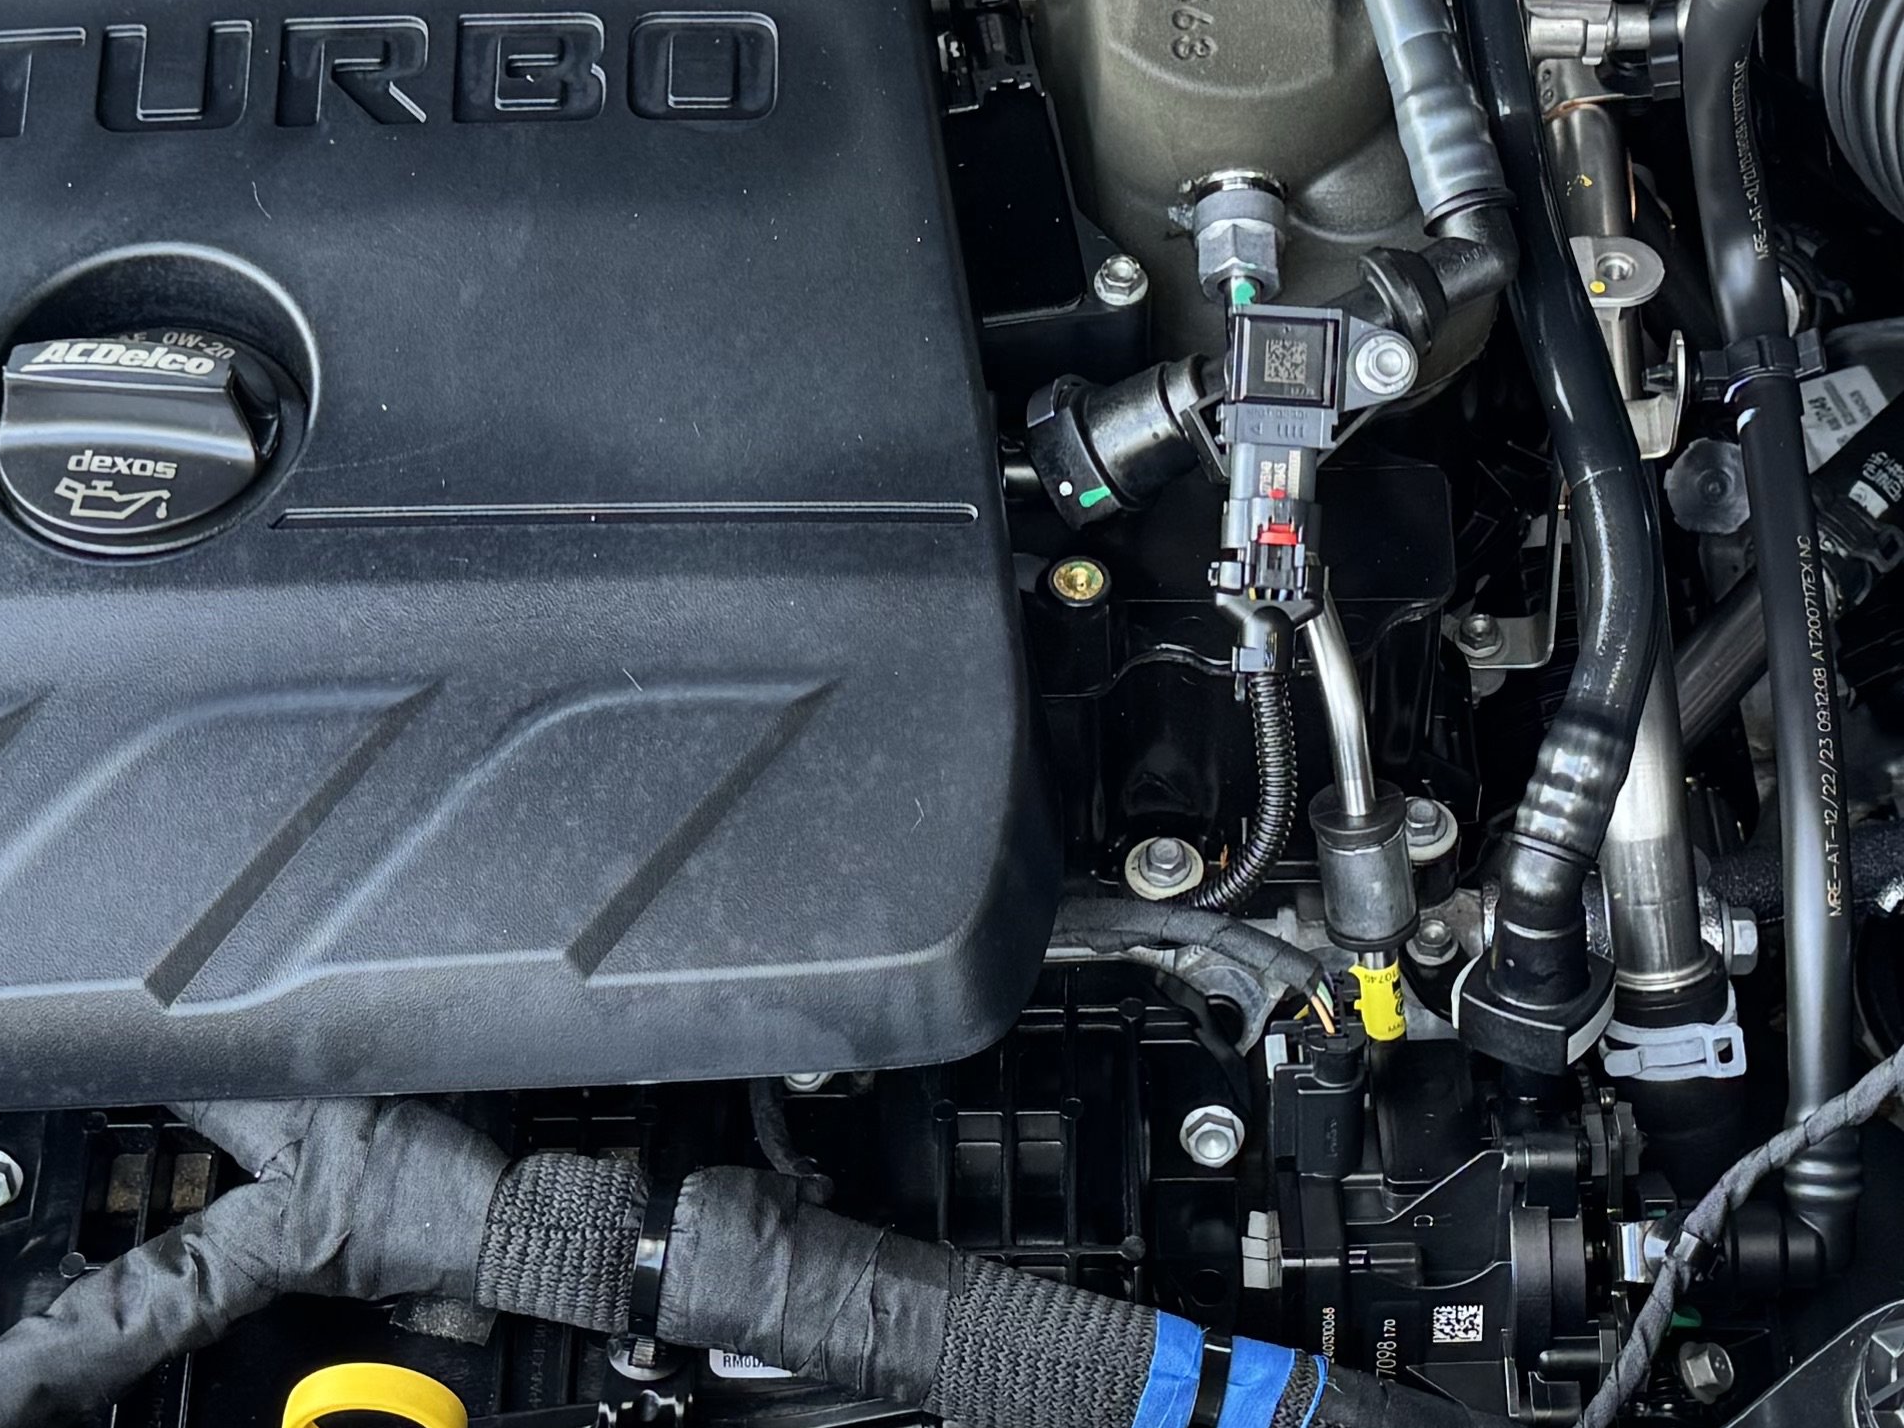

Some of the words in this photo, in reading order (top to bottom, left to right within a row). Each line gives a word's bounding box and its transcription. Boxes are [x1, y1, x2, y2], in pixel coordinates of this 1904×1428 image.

[31, 341, 216, 375] ACDelco
[67, 449, 178, 480] dexos
[1384, 1318, 1397, 1338] 170
